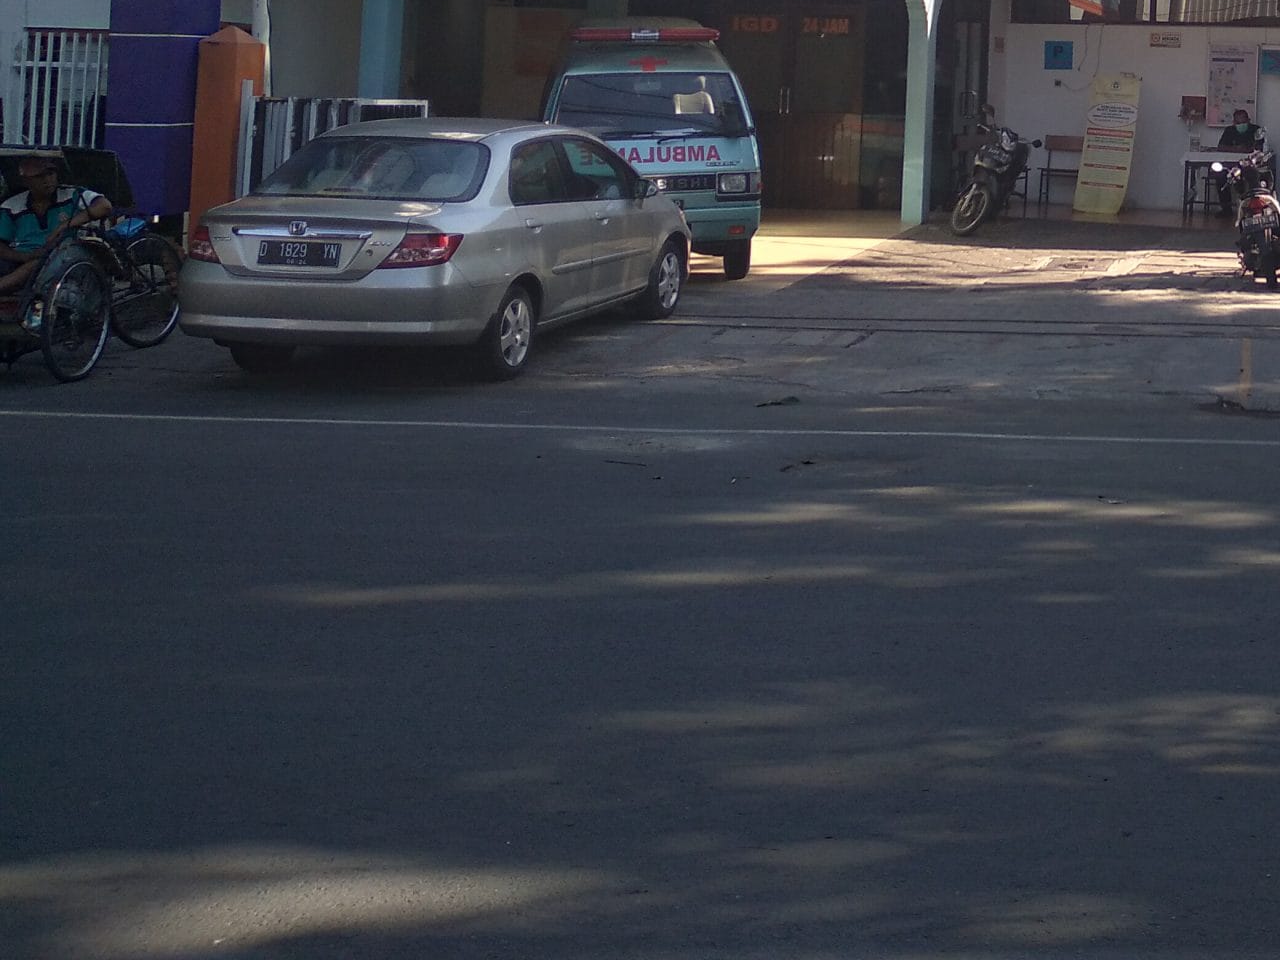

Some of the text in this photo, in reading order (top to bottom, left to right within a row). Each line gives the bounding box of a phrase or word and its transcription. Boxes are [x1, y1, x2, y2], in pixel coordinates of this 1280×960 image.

[260, 241, 338, 260] D 1829 YN
